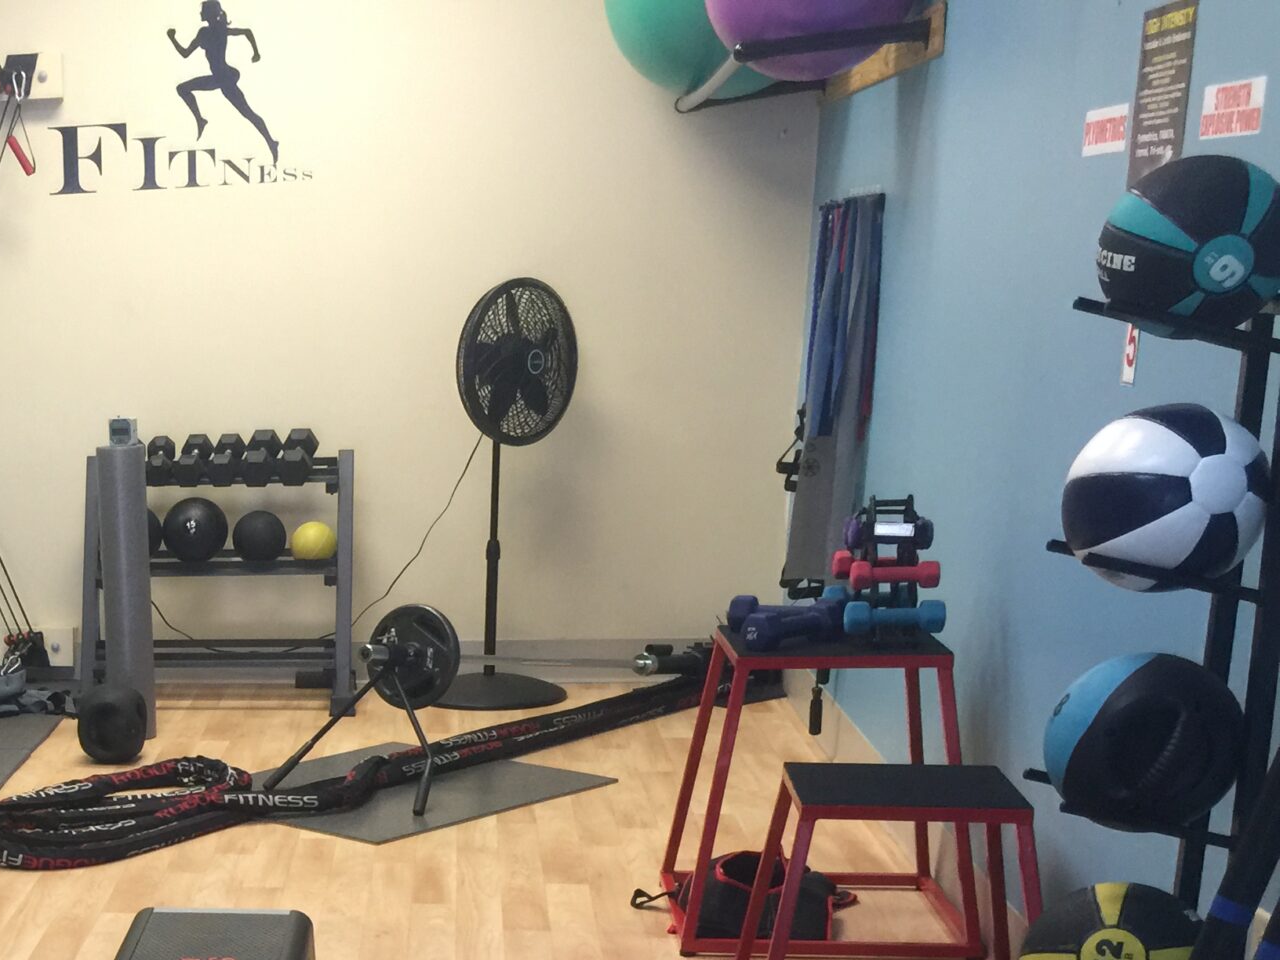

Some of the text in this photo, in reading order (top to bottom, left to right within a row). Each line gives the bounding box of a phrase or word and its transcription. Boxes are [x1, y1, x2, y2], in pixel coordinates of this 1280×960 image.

[186, 520, 197, 529] 15
[402, 751, 460, 776] FITNSS
[224, 793, 319, 808] FITNESS
